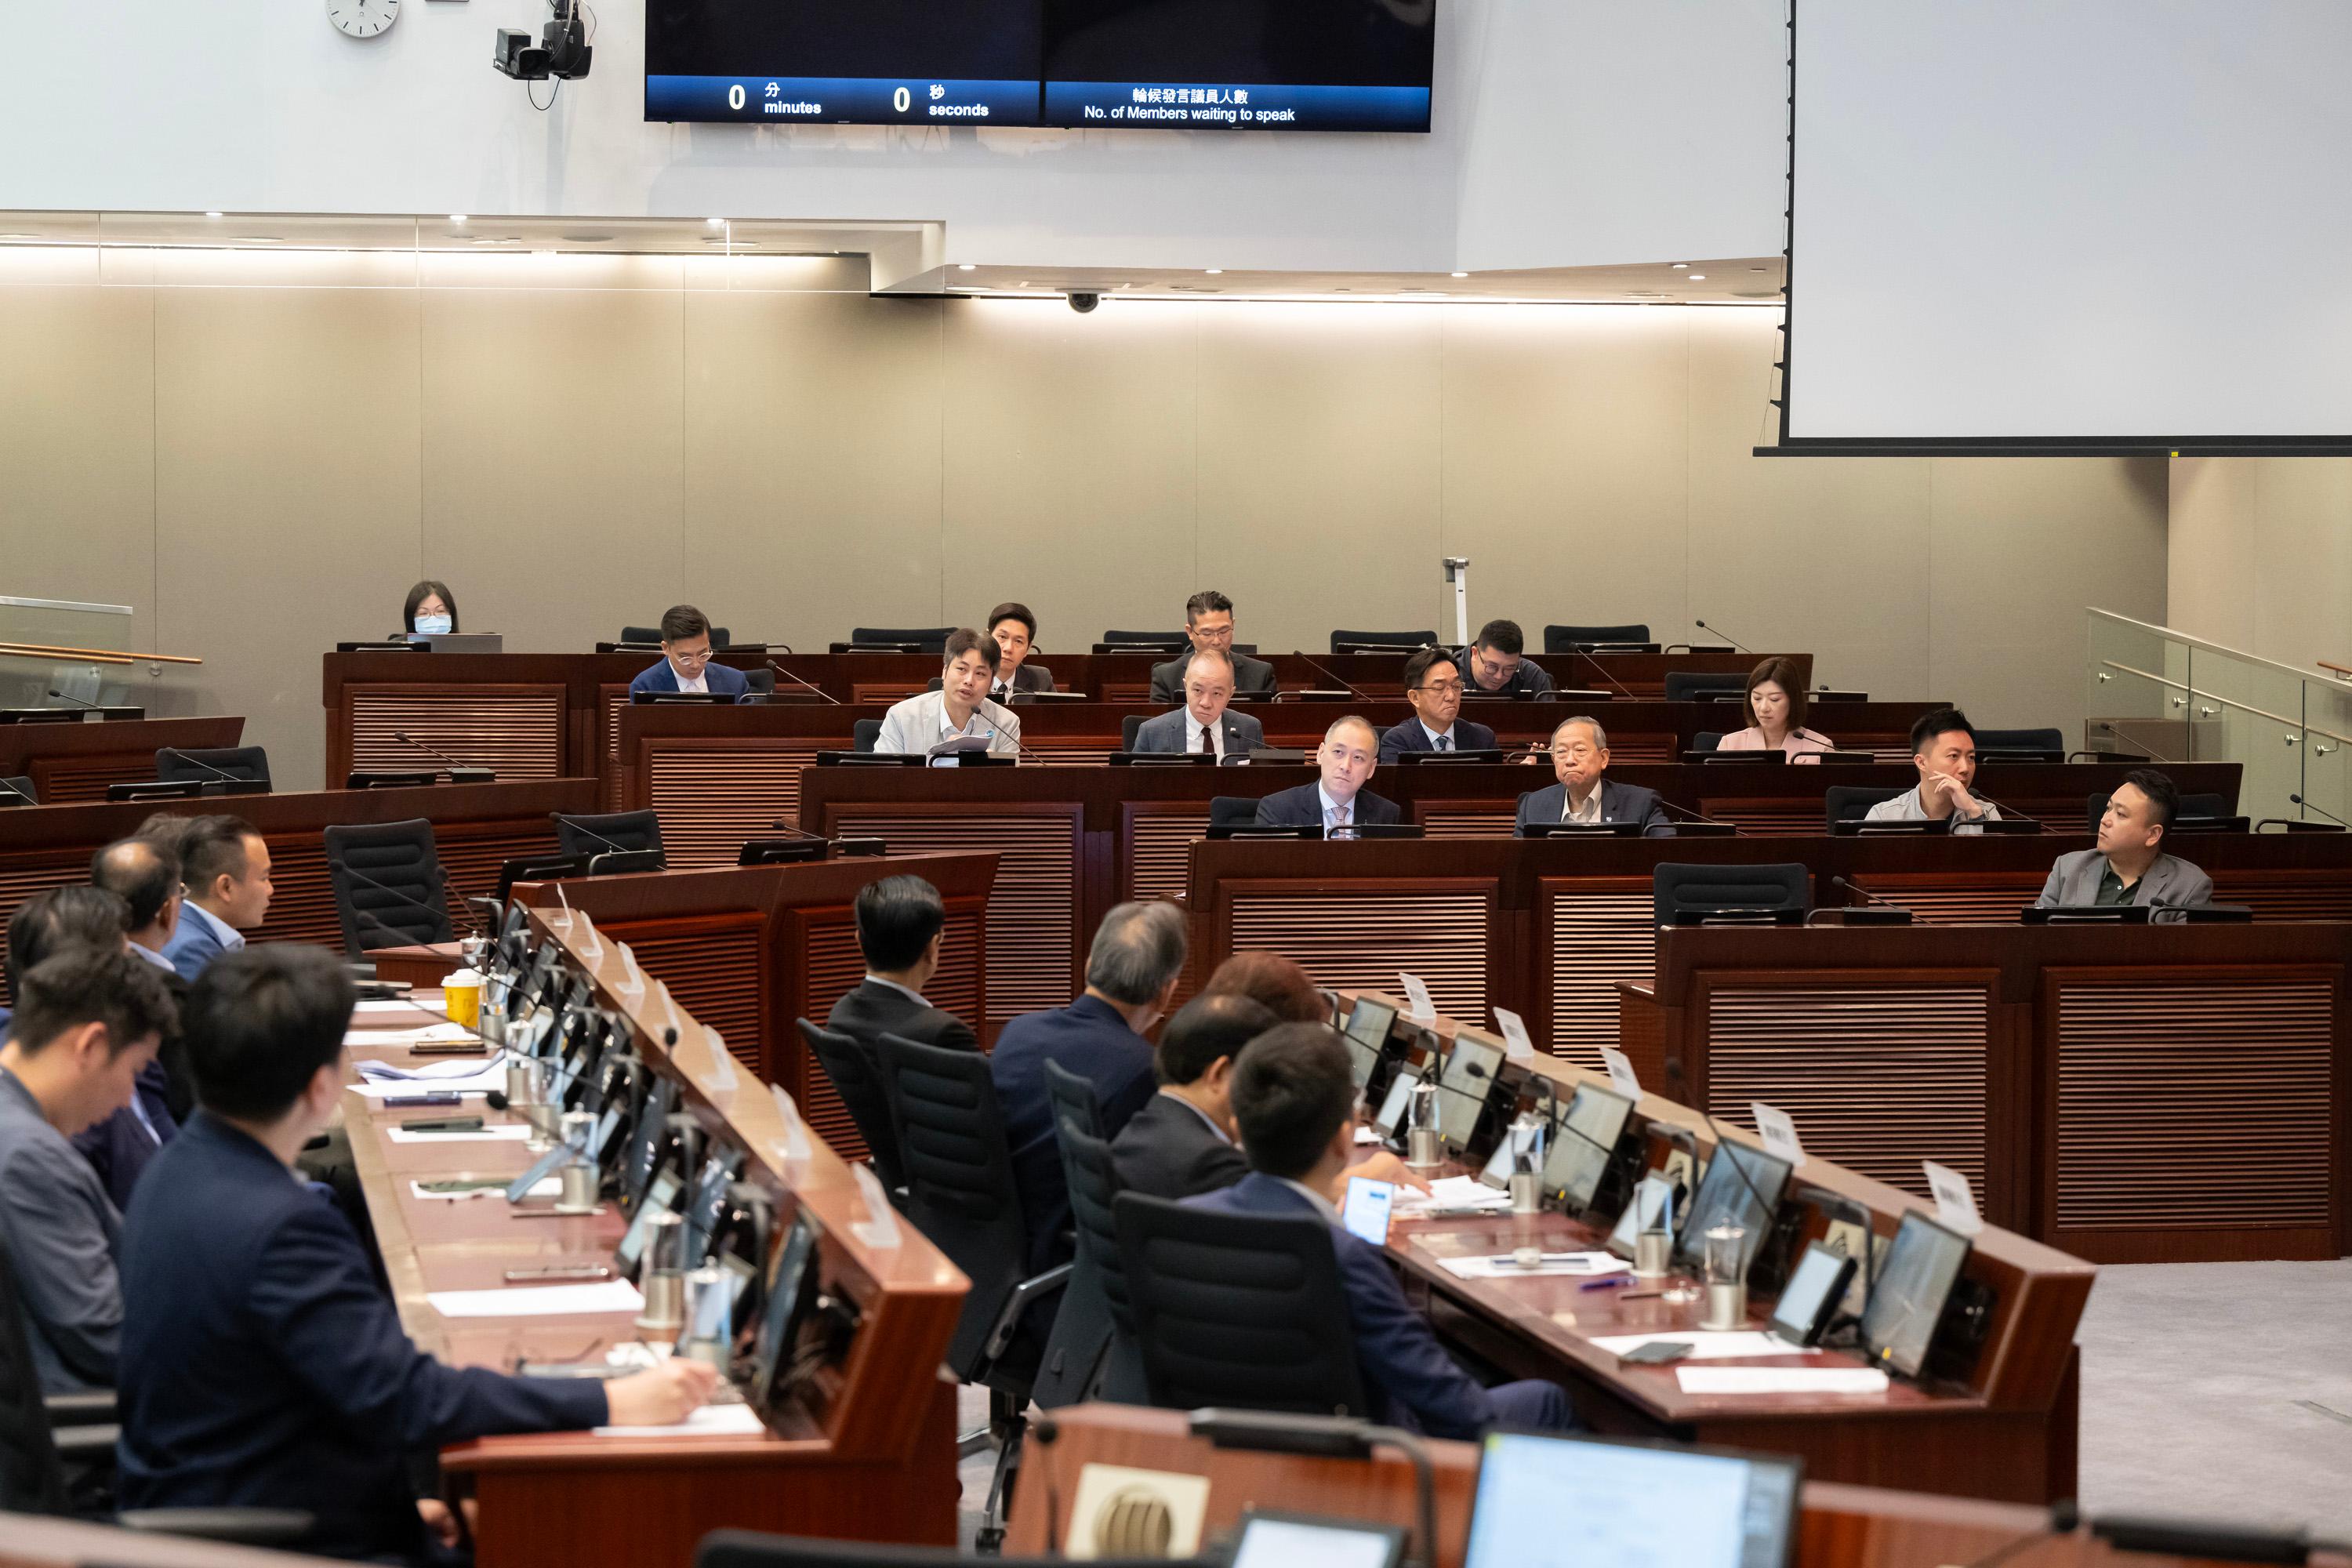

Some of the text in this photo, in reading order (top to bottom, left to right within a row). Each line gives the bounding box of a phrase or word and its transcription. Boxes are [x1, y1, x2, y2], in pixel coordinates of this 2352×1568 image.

[728, 84, 746, 110] 0
[764, 82, 781, 98] 分
[929, 84, 946, 100] 秒
[1132, 87, 1249, 104] 輪候發言議員人數
[764, 100, 822, 114] minutes
[893, 86, 911, 112] 0
[928, 103, 989, 117] seconds
[1084, 105, 1295, 124] No. of Members waiting to speak
